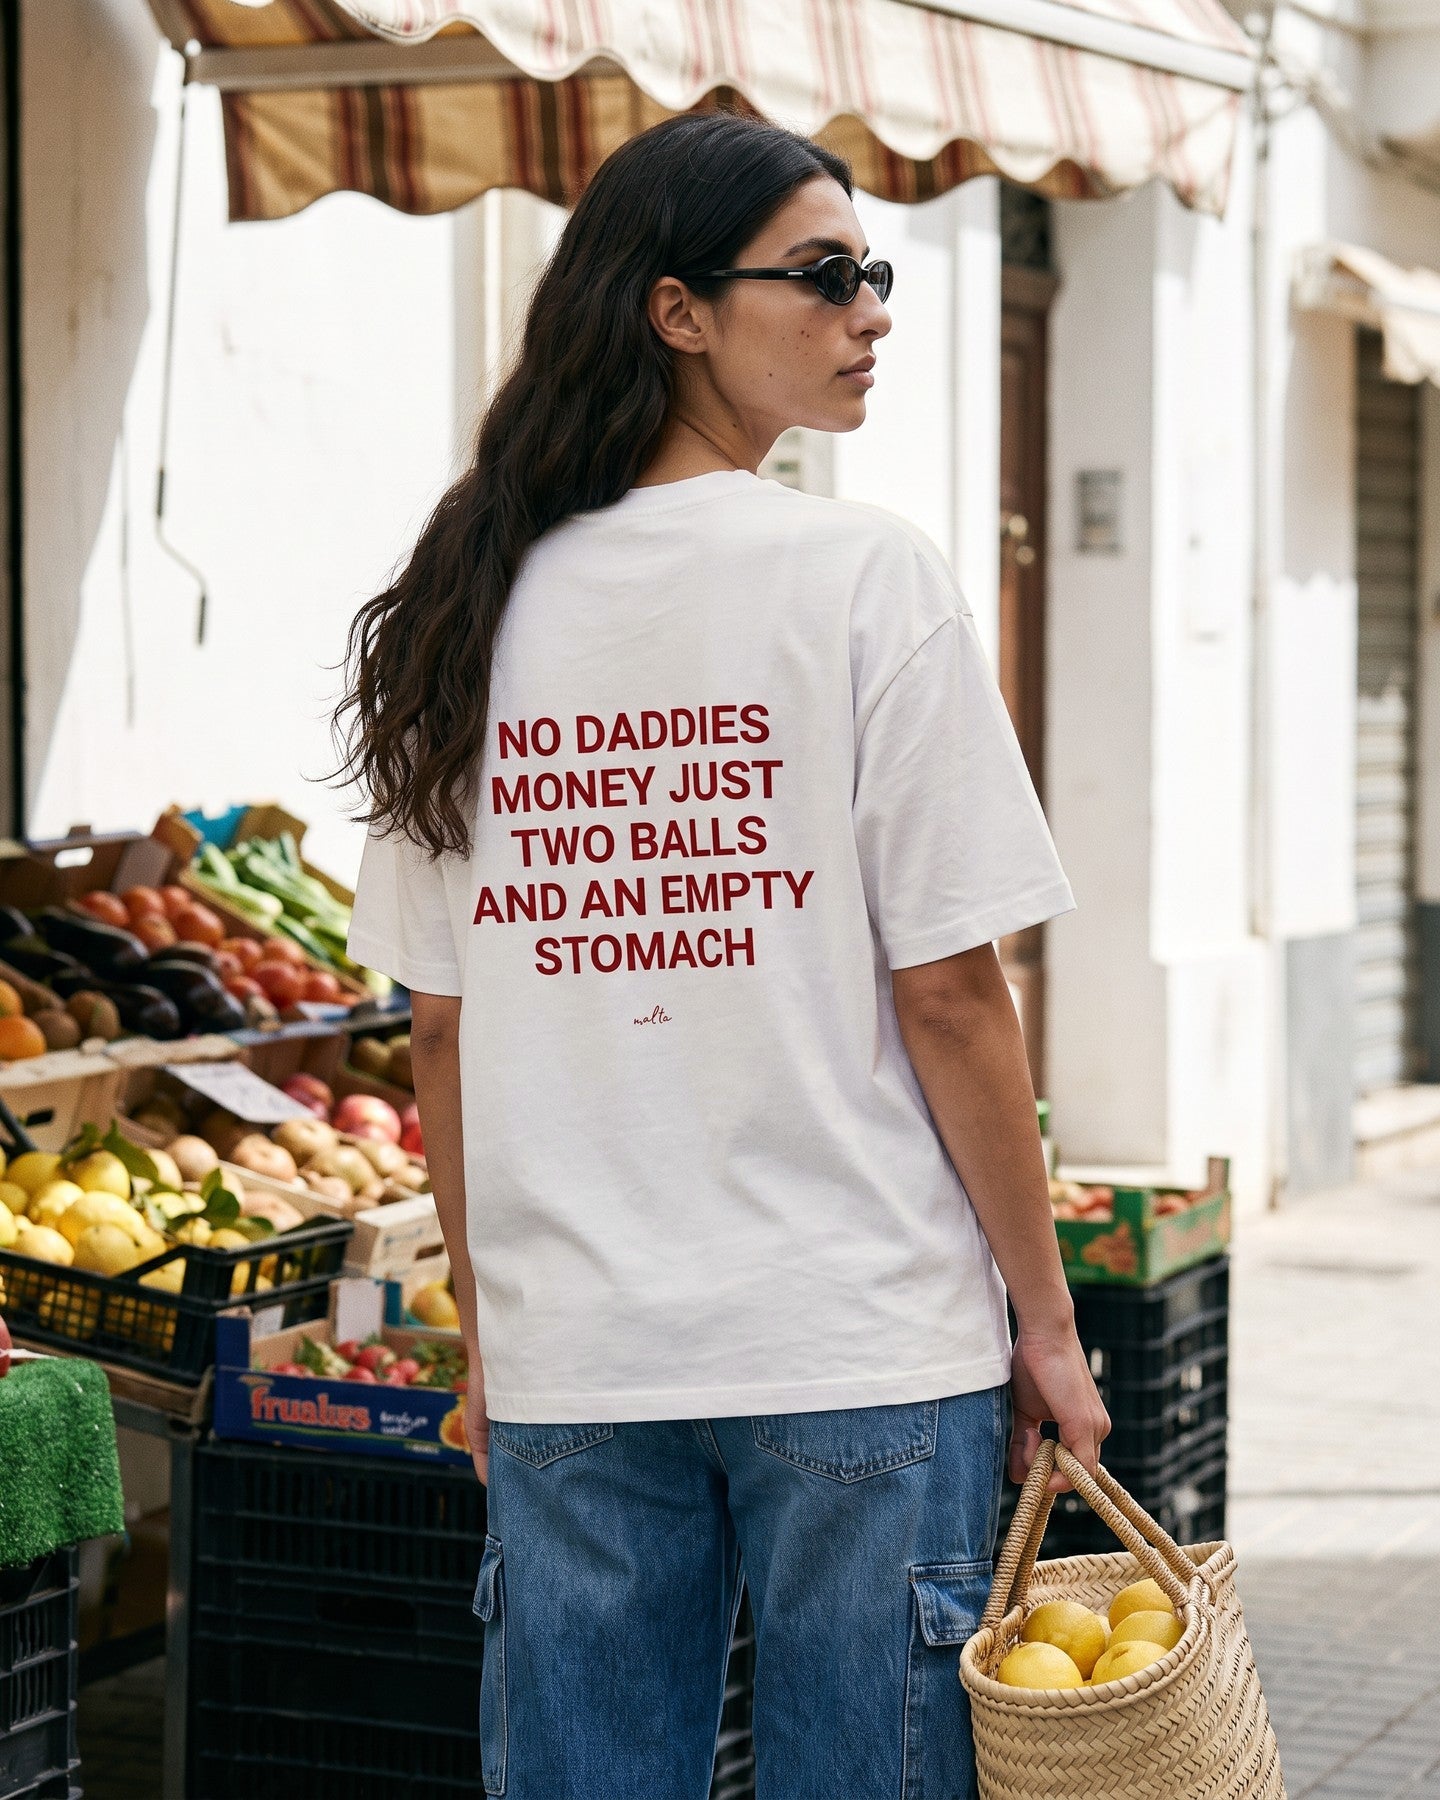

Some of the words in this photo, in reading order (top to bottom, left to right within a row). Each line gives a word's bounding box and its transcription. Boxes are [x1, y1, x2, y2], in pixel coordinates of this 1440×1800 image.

[497, 717, 562, 760] NO
[575, 703, 770, 754] DADDIES
[491, 765, 656, 815] MONEY
[669, 759, 784, 804] JUST
[510, 824, 616, 868] TWO
[629, 815, 768, 861] BALLS
[473, 882, 568, 925] AND
[580, 877, 647, 920] AN
[660, 870, 815, 915] EMPTY
[534, 927, 756, 976] STOMACH
[632, 1004, 673, 1026] malta
